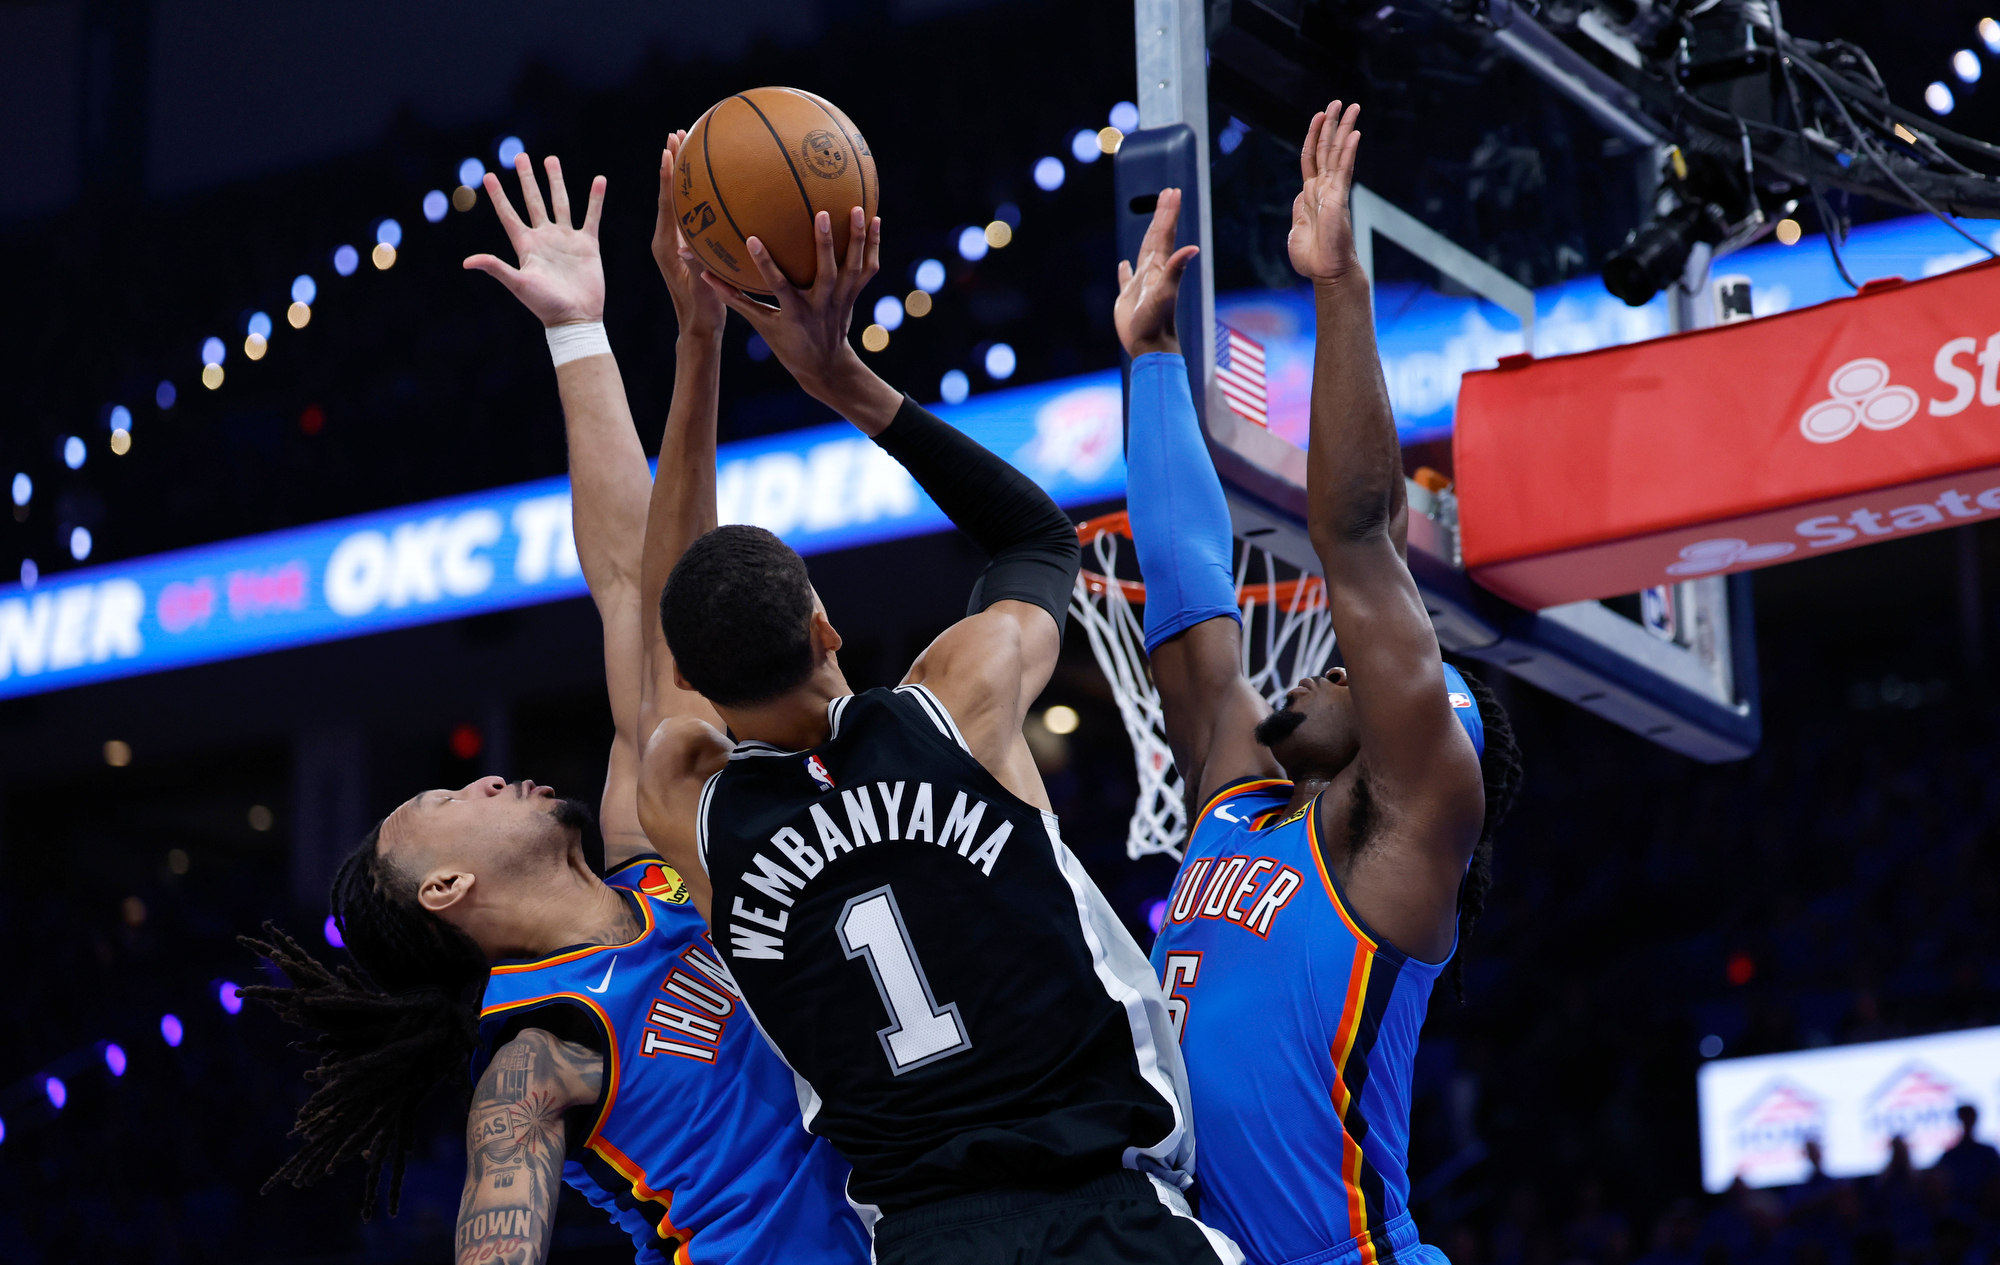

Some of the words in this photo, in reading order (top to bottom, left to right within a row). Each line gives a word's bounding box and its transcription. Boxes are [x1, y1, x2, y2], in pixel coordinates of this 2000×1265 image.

[324, 509, 501, 616] OKC
[729, 780, 1014, 960] WEMBANYAMA
[638, 929, 742, 1065] THUN
[835, 884, 972, 1077] 1
